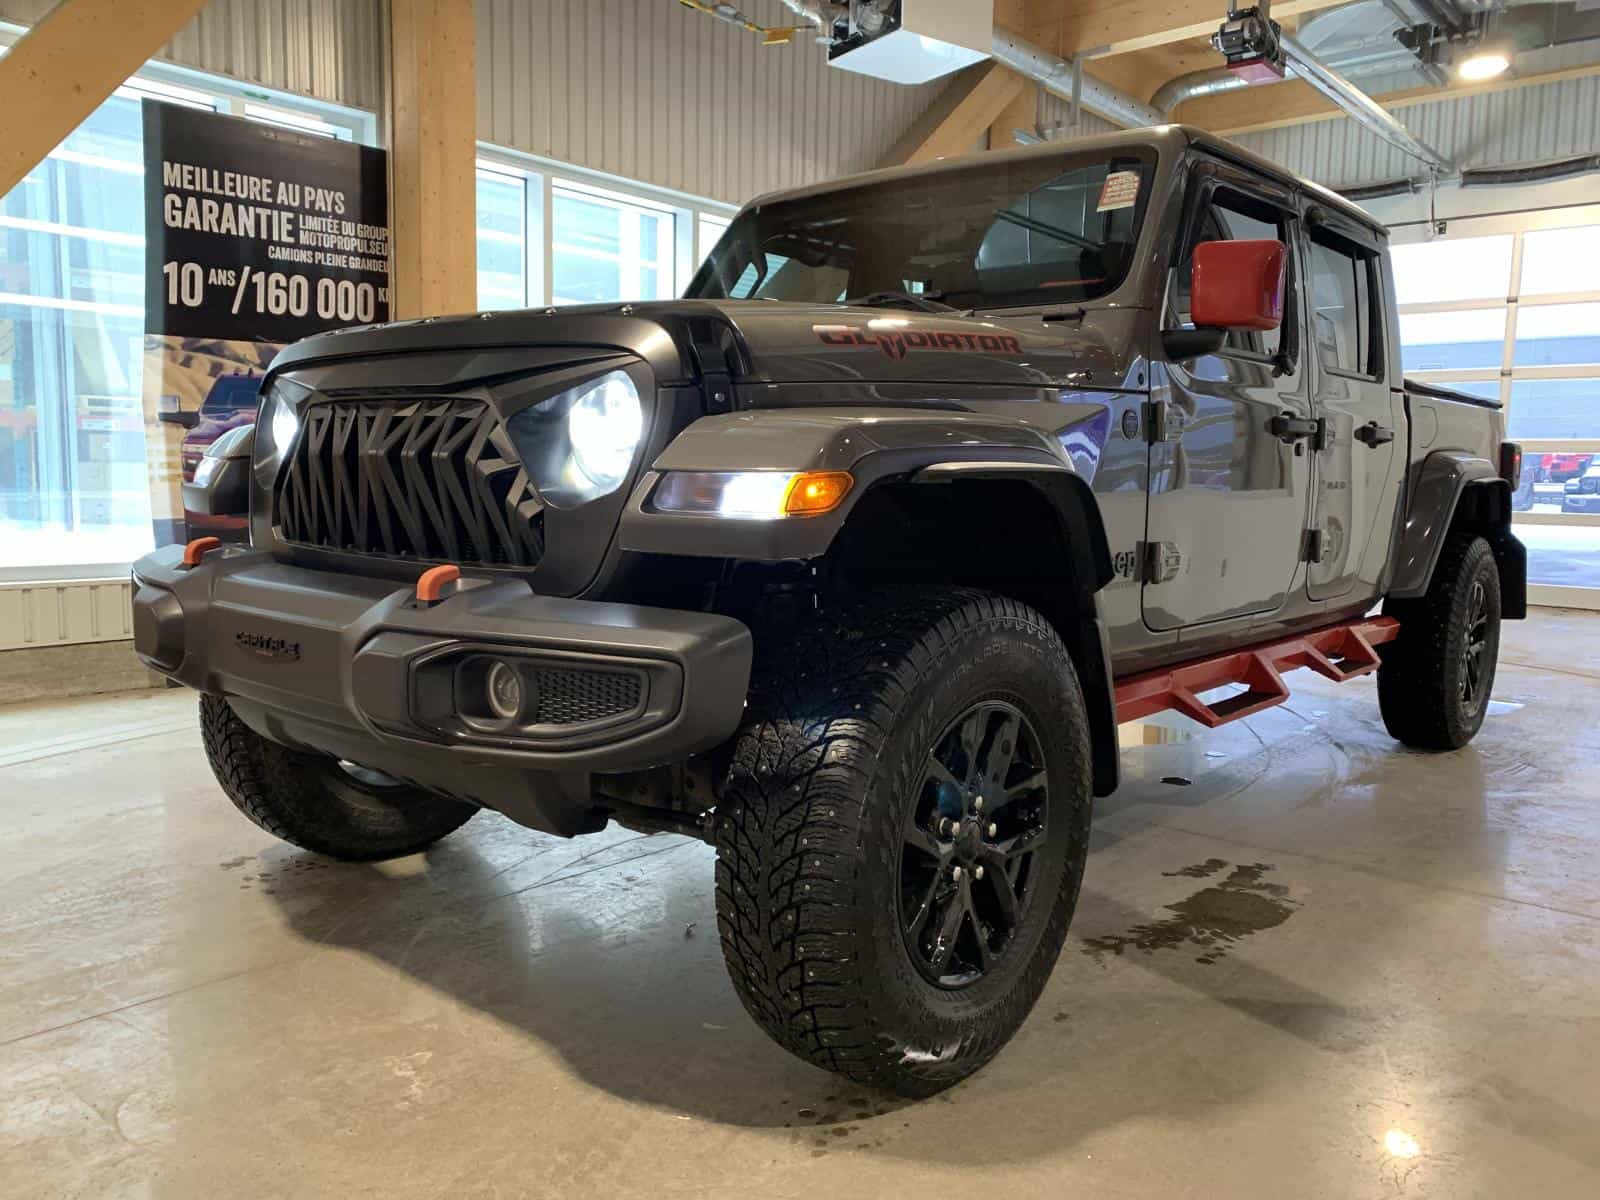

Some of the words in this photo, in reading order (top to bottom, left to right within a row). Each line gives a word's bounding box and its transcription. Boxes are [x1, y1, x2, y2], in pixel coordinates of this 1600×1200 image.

[163, 161, 273, 203] MEILLEURE
[276, 181, 301, 208] AU
[304, 186, 345, 215] PAYS
[164, 193, 295, 243] GARANTIE
[299, 214, 340, 234] LIMITÉE
[341, 221, 356, 237] DU
[267, 245, 313, 264] CAMIONS
[314, 251, 348, 268] PLEINE
[163, 260, 204, 307] 10
[317, 277, 375, 323] 000
